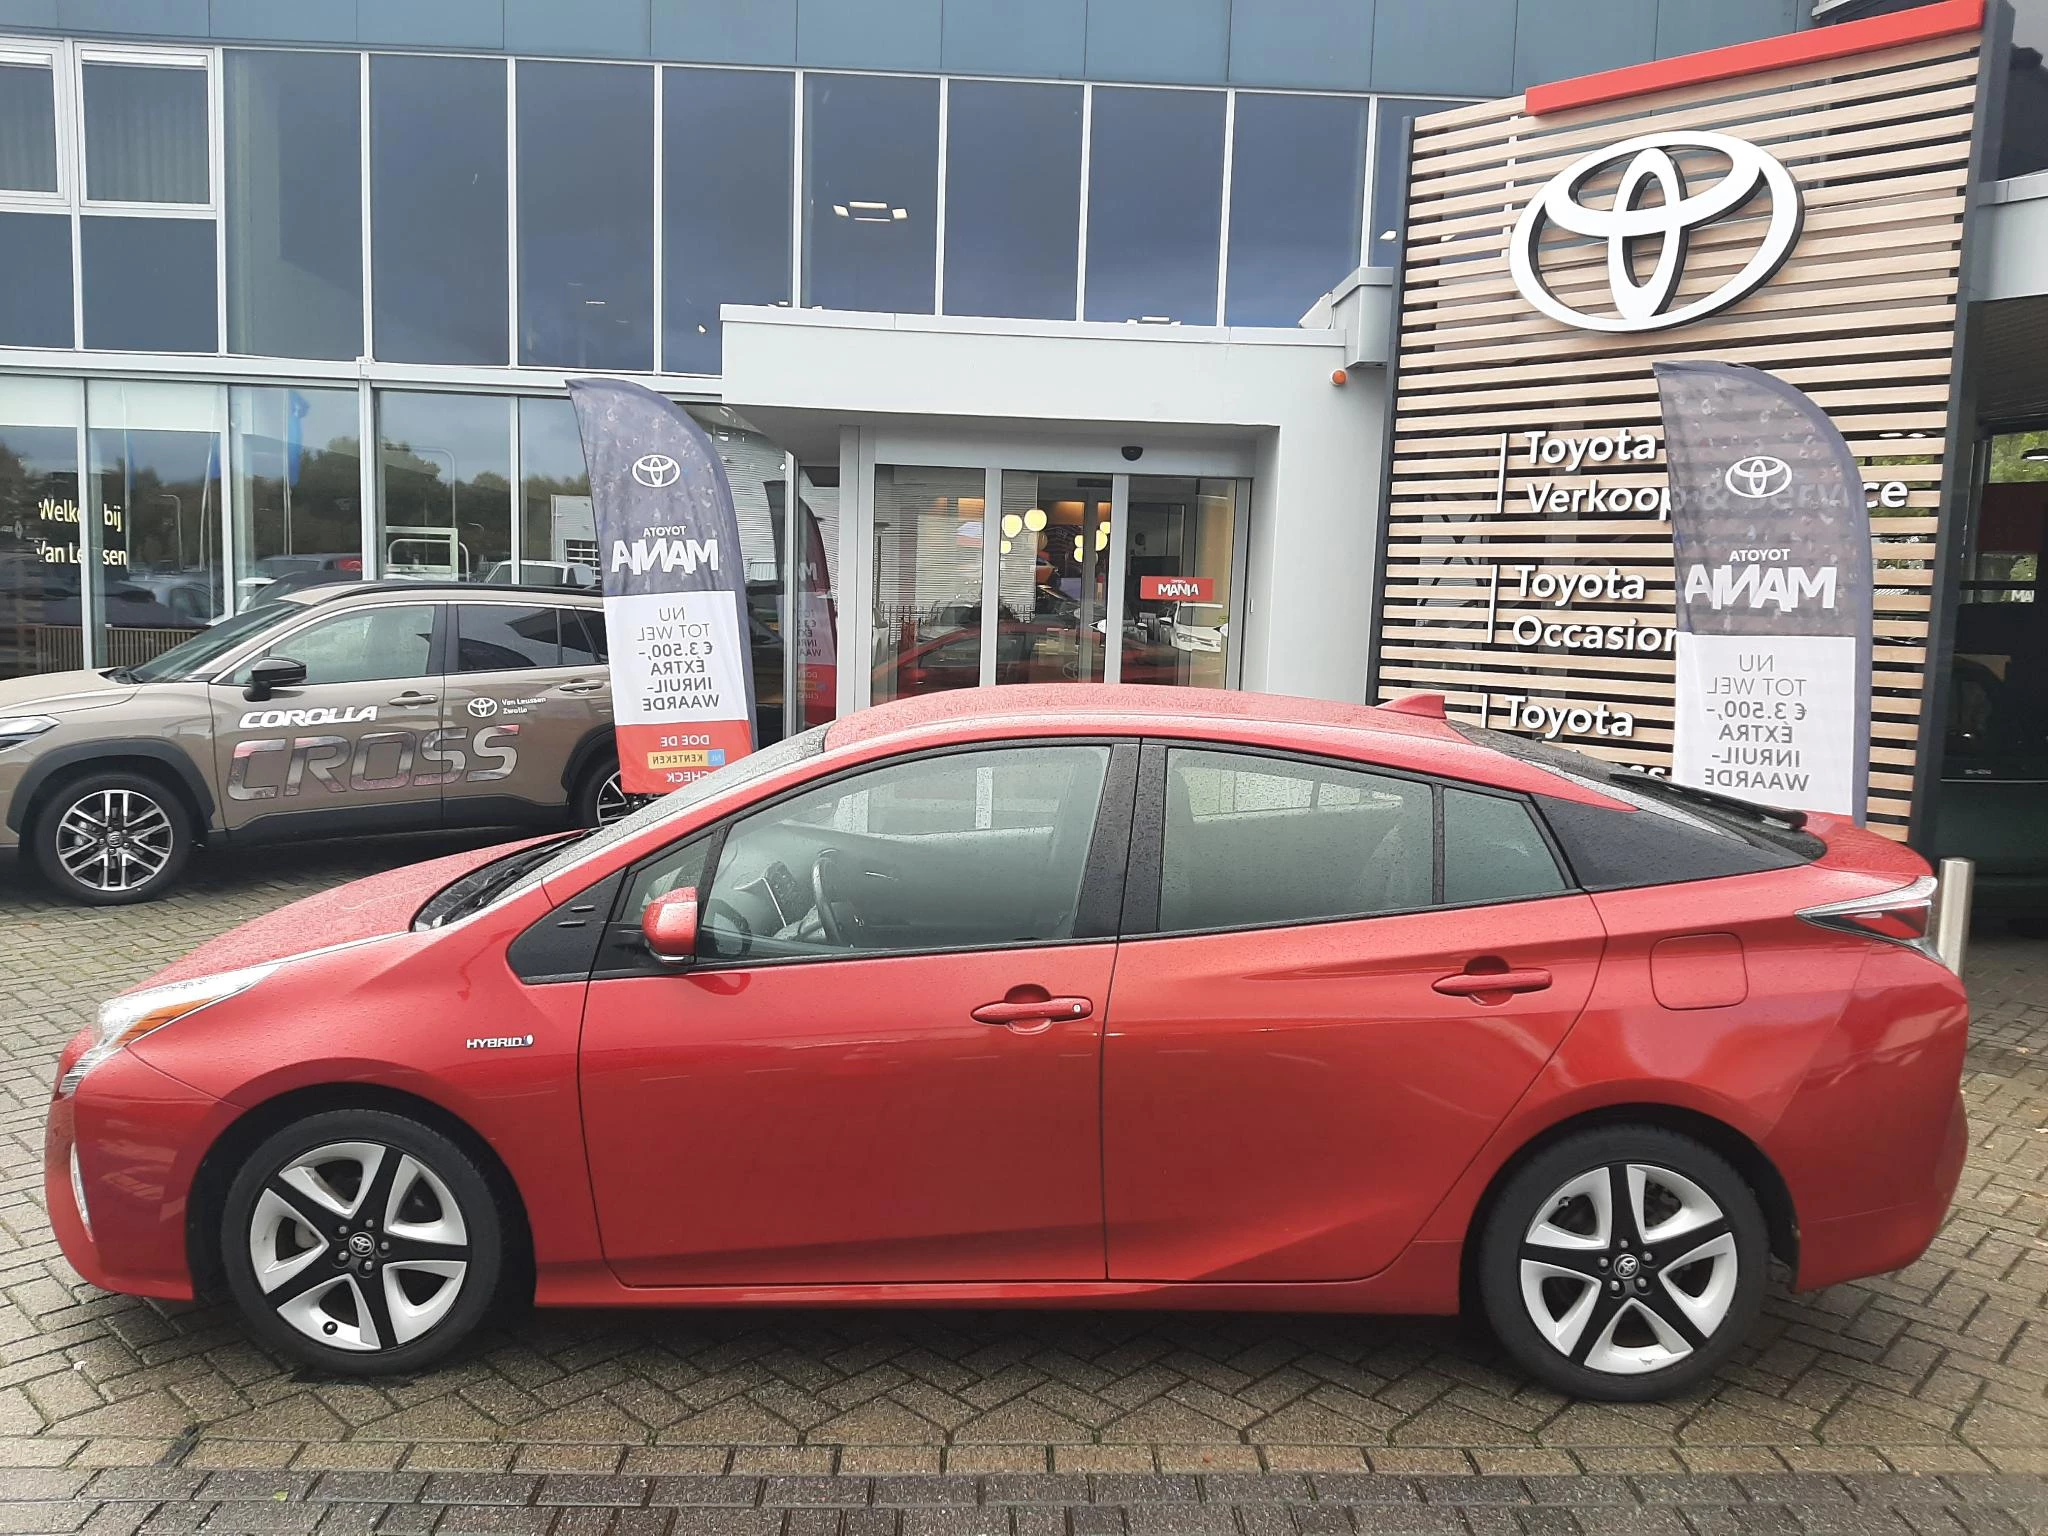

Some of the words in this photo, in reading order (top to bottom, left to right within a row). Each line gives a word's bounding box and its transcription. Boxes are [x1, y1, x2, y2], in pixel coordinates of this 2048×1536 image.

[1524, 430, 1656, 471] Toyota
[103, 503, 122, 532] bij
[1527, 480, 1686, 521] Verkoop
[36, 540, 65, 563] Van
[1158, 583, 1199, 597] MANIA
[1514, 565, 1645, 606] Toyota
[239, 706, 379, 729] COROLLA
[1505, 695, 1634, 739] Toyota
[227, 724, 520, 801] CROSS
[466, 1036, 523, 1049] HYBRID
